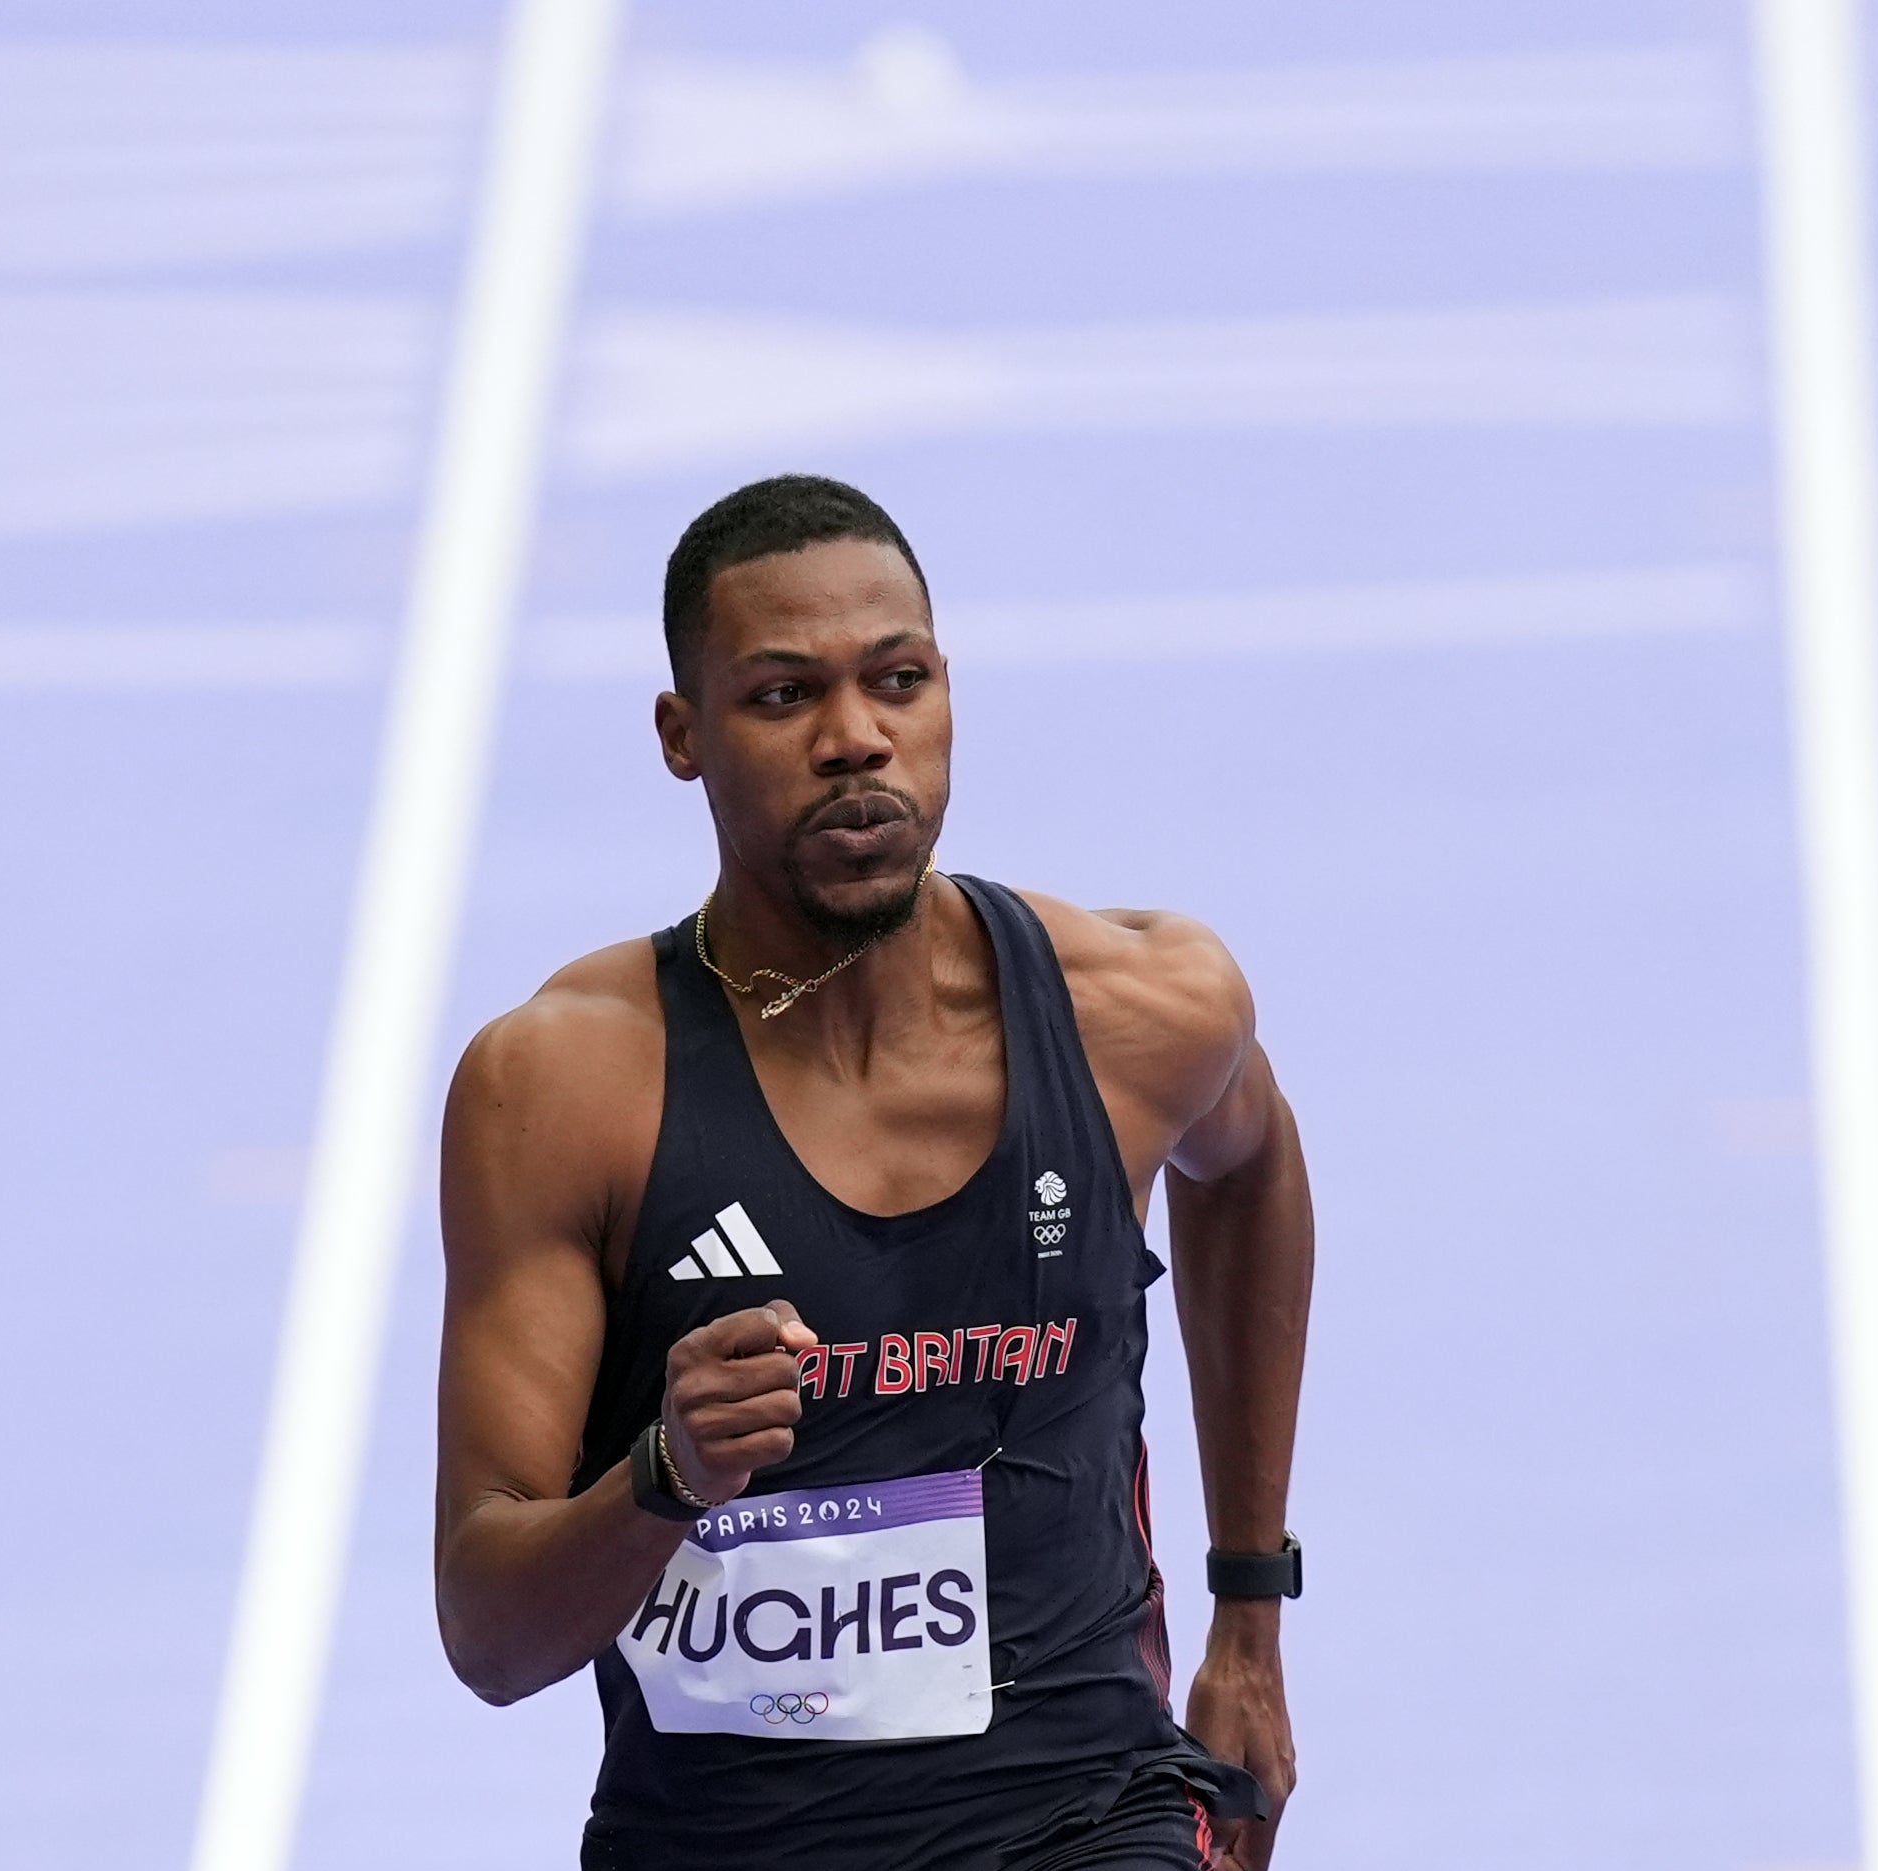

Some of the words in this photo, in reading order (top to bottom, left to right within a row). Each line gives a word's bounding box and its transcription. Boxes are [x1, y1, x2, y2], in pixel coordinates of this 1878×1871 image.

[1028, 1209, 1056, 1222] TEAM
[1057, 1207, 1072, 1219] GB
[797, 1496, 883, 1525] 2024
[630, 1568, 978, 1662] HUGHES
